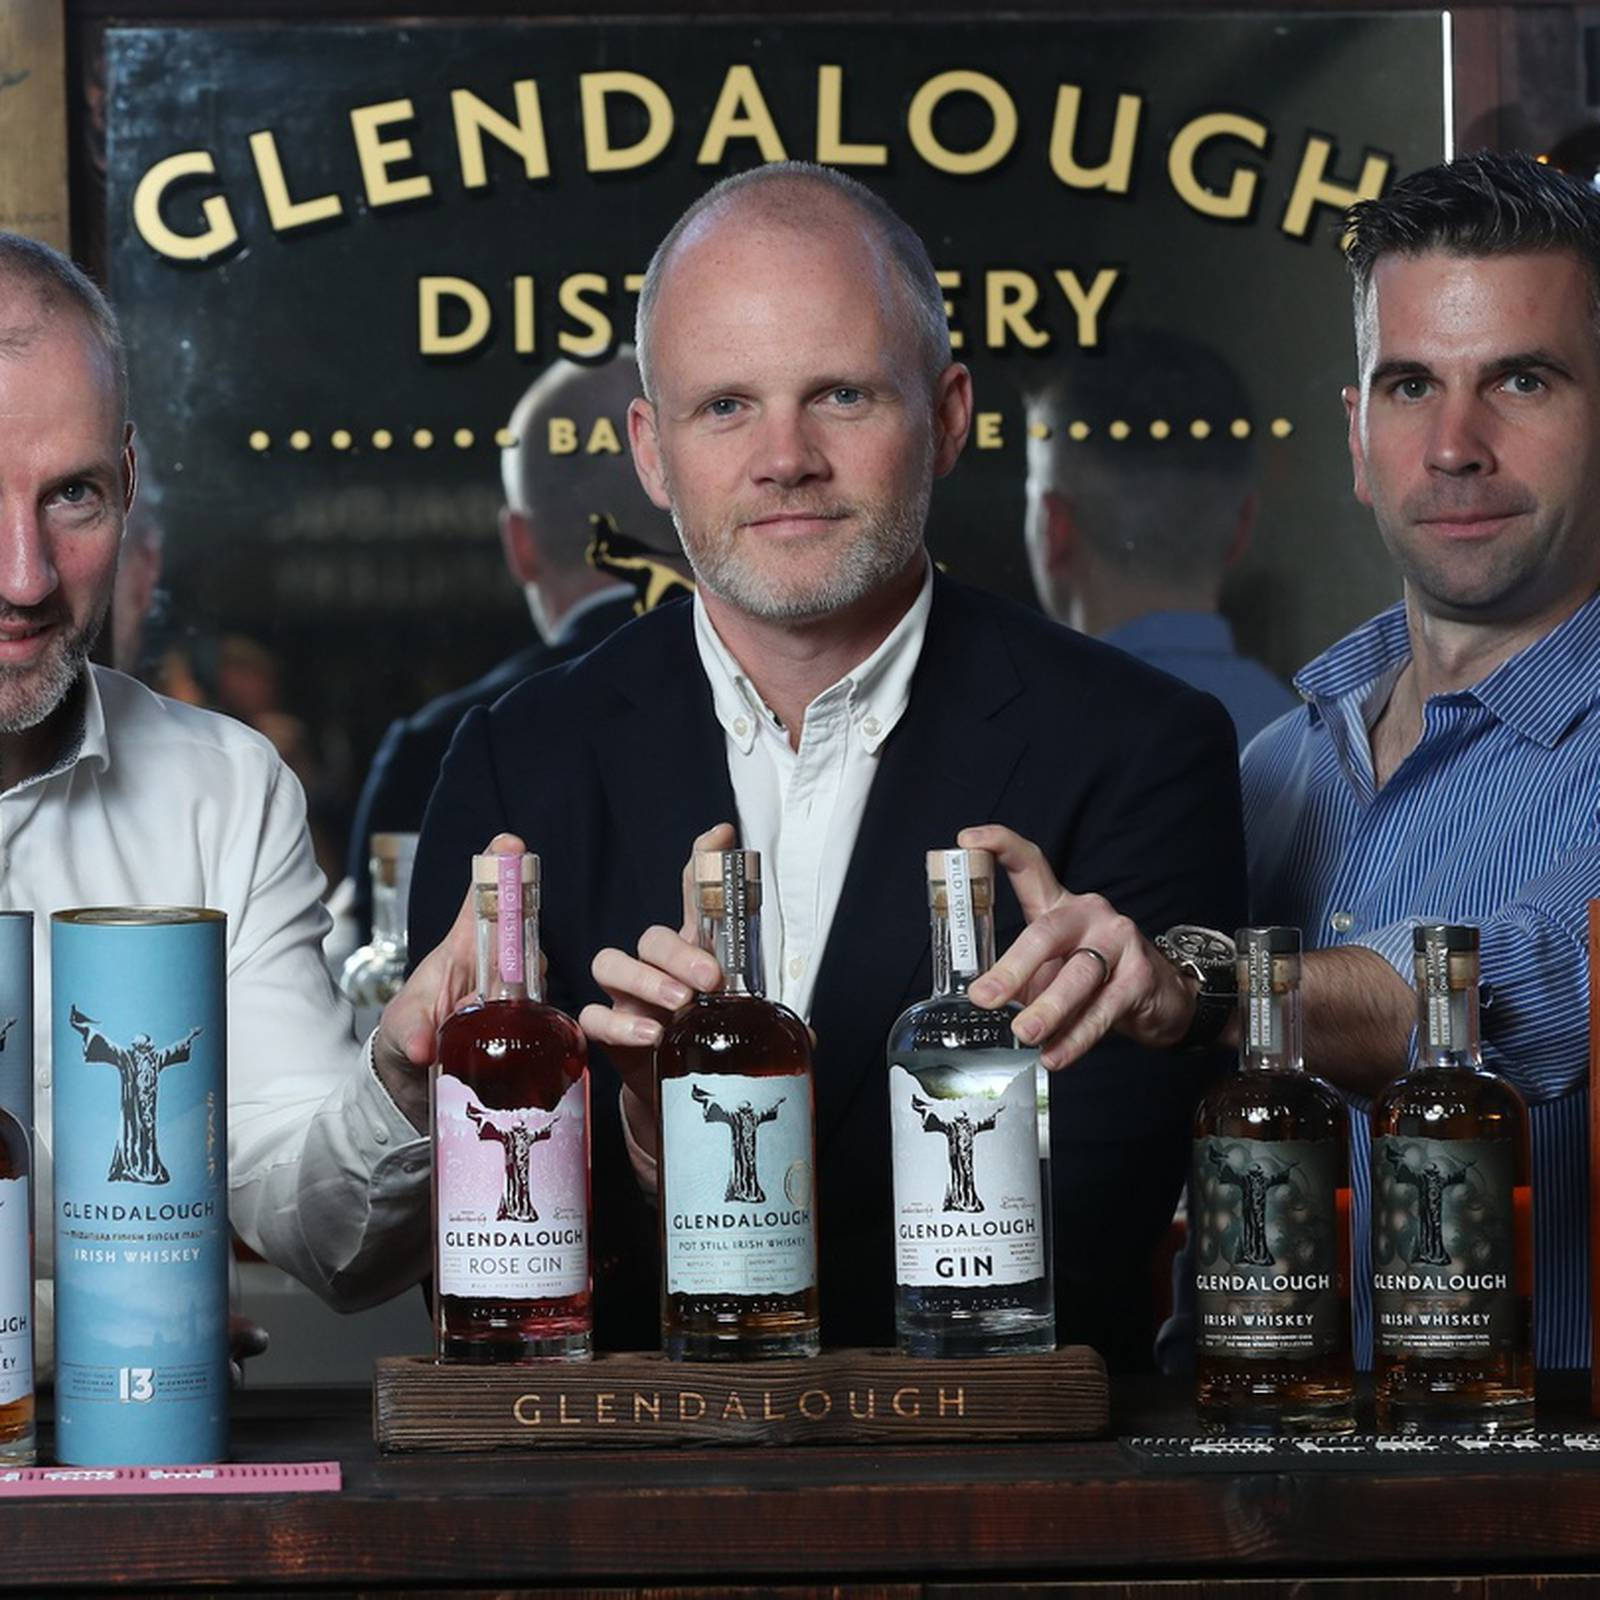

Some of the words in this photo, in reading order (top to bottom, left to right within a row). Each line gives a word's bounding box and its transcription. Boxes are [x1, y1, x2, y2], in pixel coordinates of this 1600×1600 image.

[133, 65, 1391, 261] GLENDALOUGH
[62, 1201, 215, 1221] GLENDALOUGH
[673, 1209, 810, 1230] GLENDALOUGH
[445, 1230, 582, 1247] GLENDALOUGH
[899, 1219, 1036, 1239] GLENDALOUGH
[700, 1241, 730, 1251] STILL
[732, 1239, 764, 1249] IRISH
[74, 1249, 117, 1264] IRISH
[123, 1248, 201, 1264] WHISKEY
[469, 1257, 520, 1275] ROSE
[527, 1256, 563, 1273] GIN
[935, 1255, 993, 1279] GIN
[1195, 1274, 1331, 1292] GLENDALOUGH
[1373, 1274, 1507, 1292] GLENDALOUGH
[1203, 1314, 1237, 1326] IRISH
[1242, 1314, 1315, 1327] WHISKEY
[1380, 1314, 1414, 1326] IRISH
[1418, 1313, 1491, 1327] WHISKEY
[118, 1366, 157, 1404] 13
[512, 1387, 967, 1426] GLENDALOUGH
